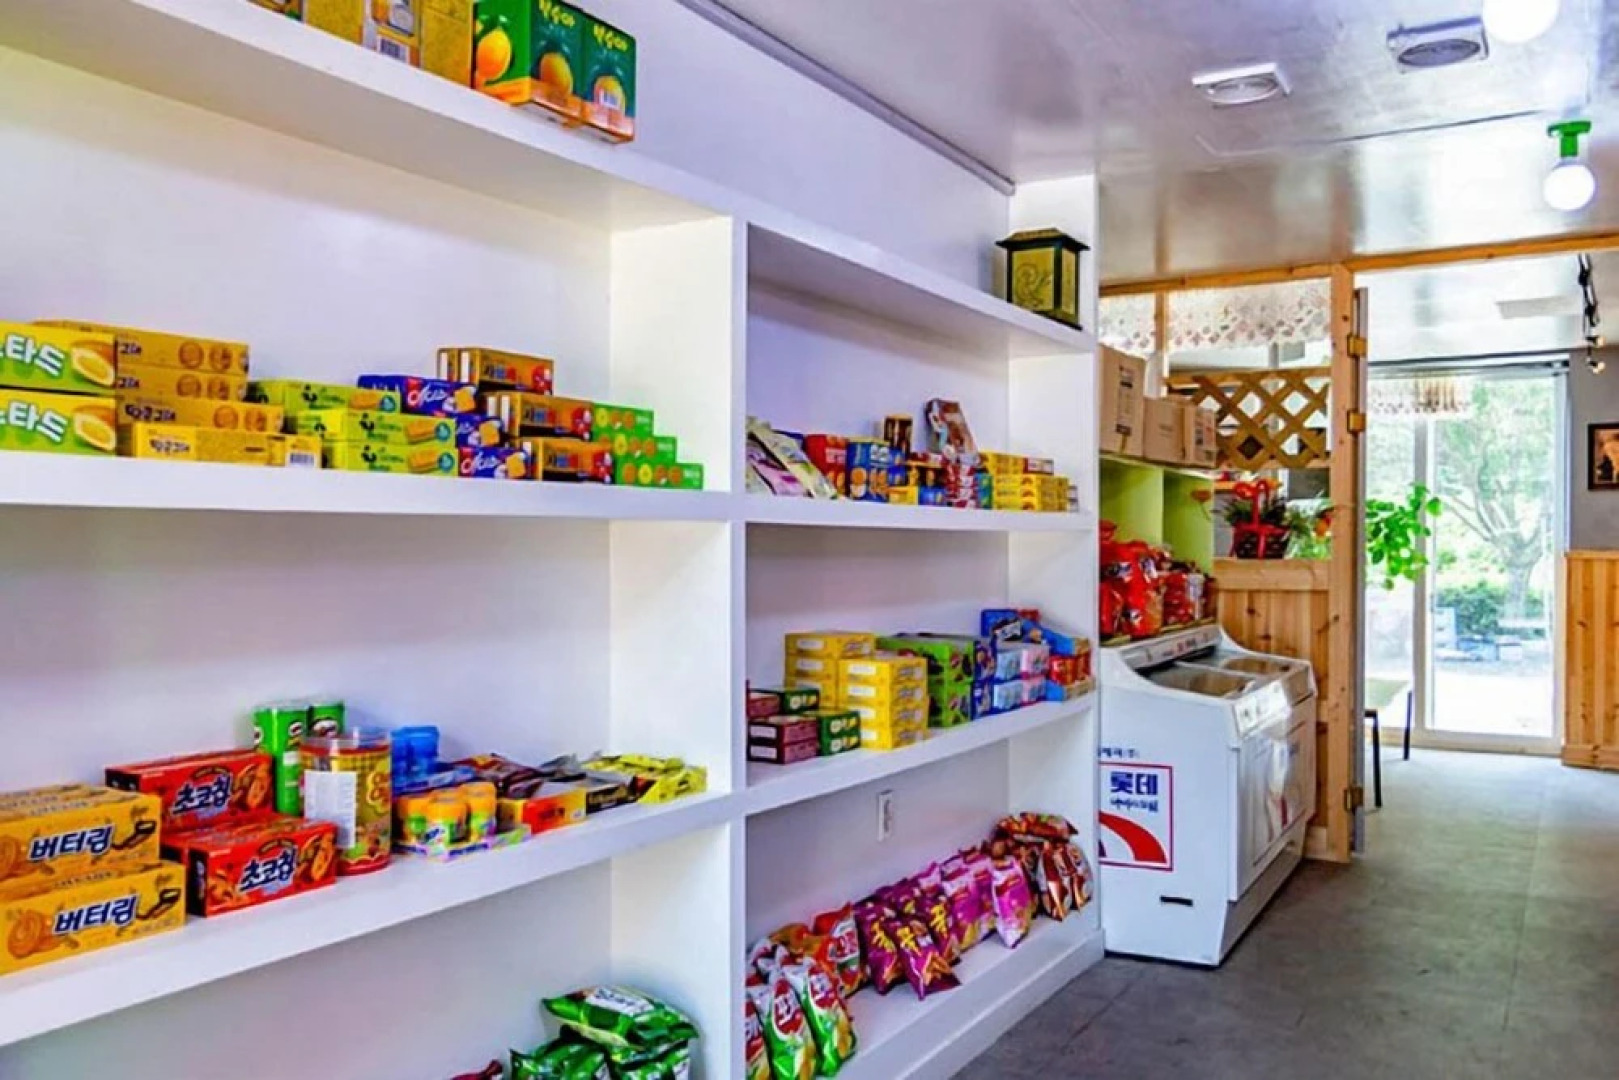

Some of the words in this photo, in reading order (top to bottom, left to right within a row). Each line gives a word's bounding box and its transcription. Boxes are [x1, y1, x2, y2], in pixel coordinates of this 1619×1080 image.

[0, 333, 66, 378] 타드
[0, 400, 70, 444] 타드
[172, 774, 232, 815] 초코칩
[1110, 771, 1158, 795] 롯데
[29, 824, 113, 860] 버터링
[239, 847, 298, 892] 초코칩
[53, 894, 138, 935] 버터링
